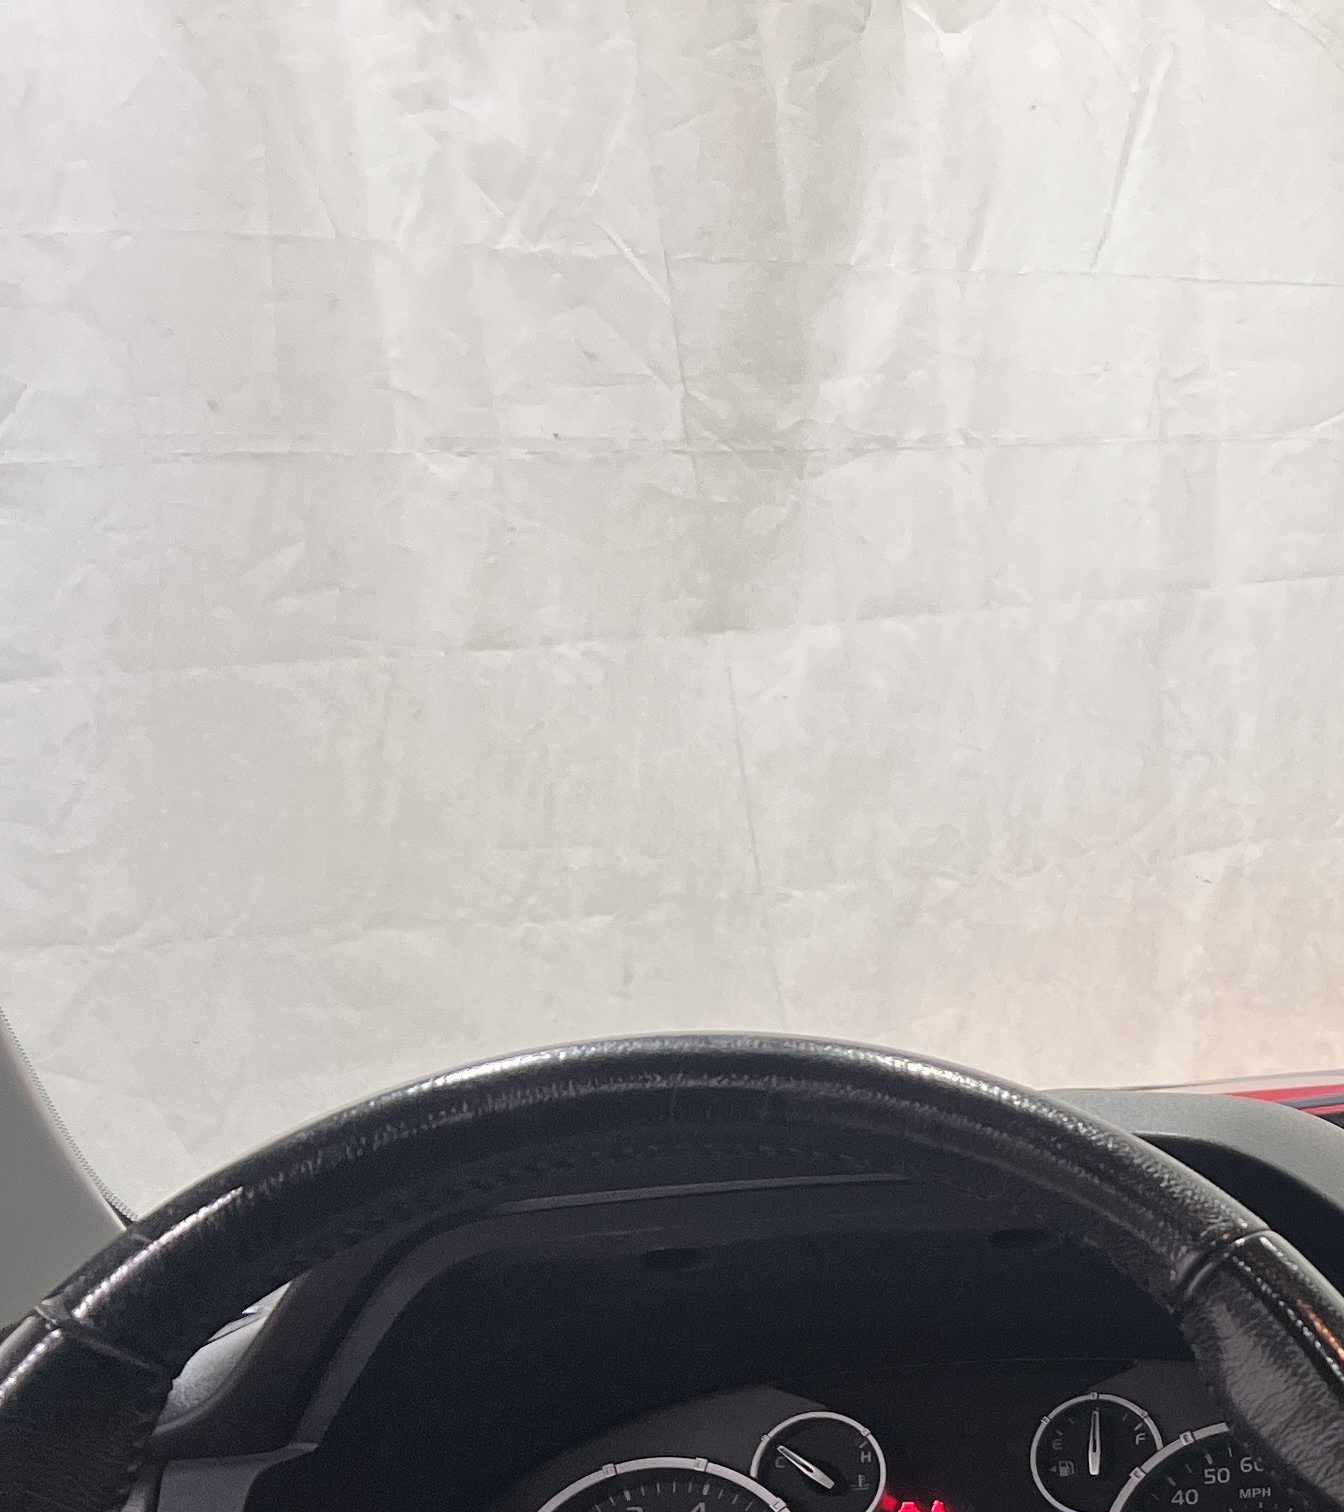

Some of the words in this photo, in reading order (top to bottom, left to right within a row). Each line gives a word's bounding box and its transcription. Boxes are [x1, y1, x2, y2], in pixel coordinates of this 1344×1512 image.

[1135, 1432, 1146, 1445] F
[860, 1450, 872, 1463] H
[1203, 1467, 1230, 1485] 50
[1171, 1488, 1199, 1506] 40
[1239, 1487, 1271, 1499] MPH
